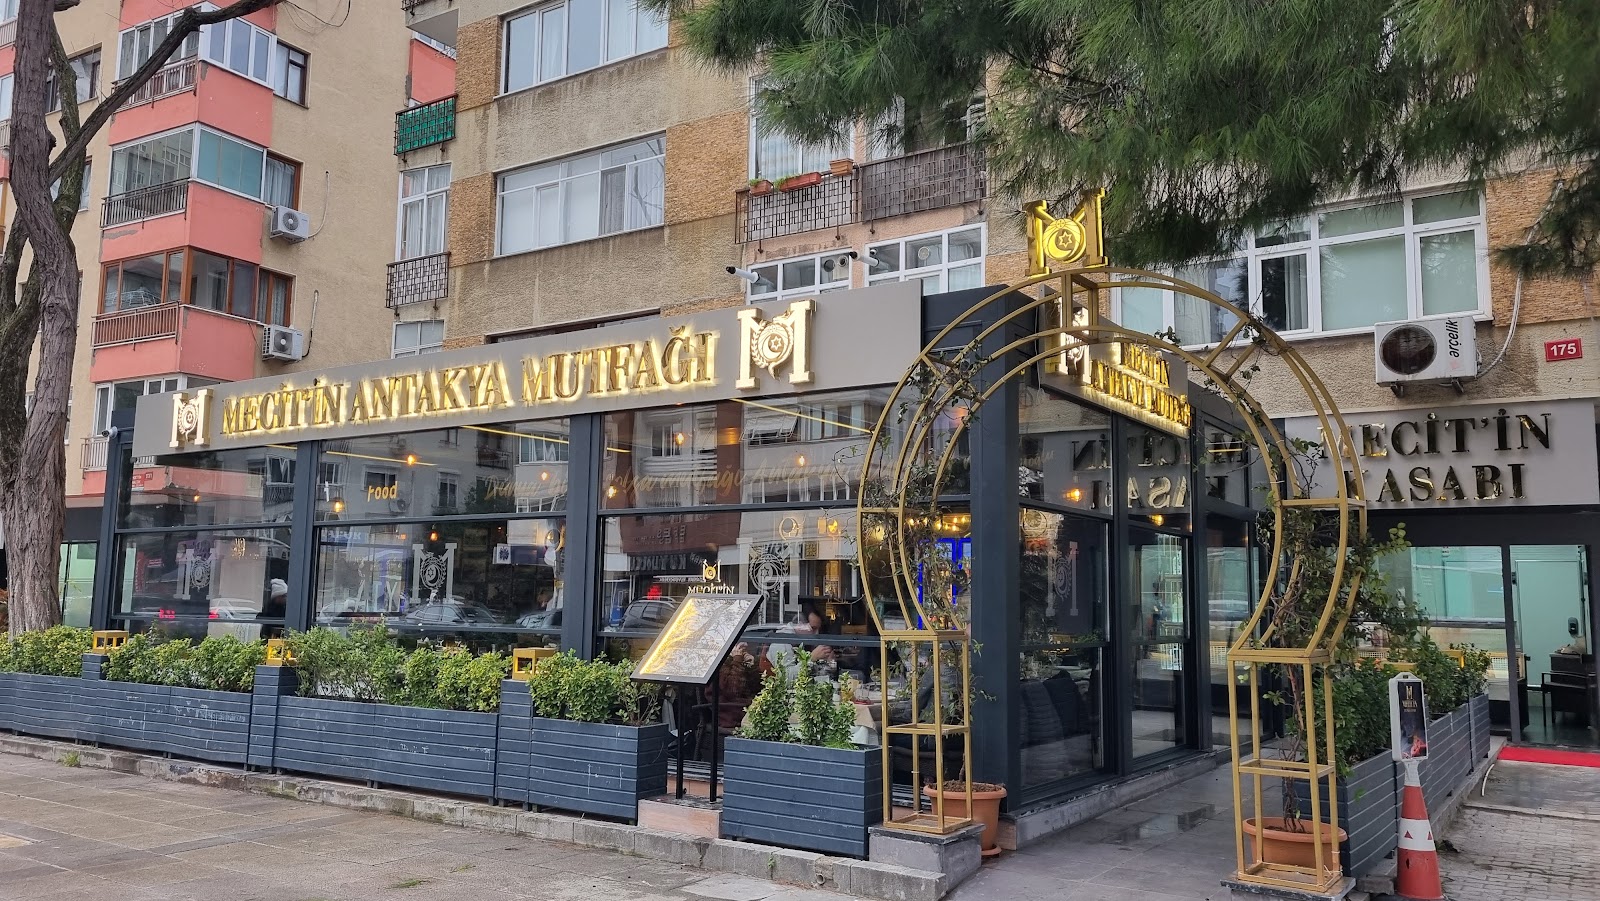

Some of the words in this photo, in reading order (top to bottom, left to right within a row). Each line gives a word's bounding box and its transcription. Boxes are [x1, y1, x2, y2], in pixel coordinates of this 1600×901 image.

[1445, 317, 1460, 358] arçelik
[1550, 342, 1577, 357] 175
[350, 361, 508, 421] ANTAKYA
[521, 324, 716, 401] MUTFAĞI
